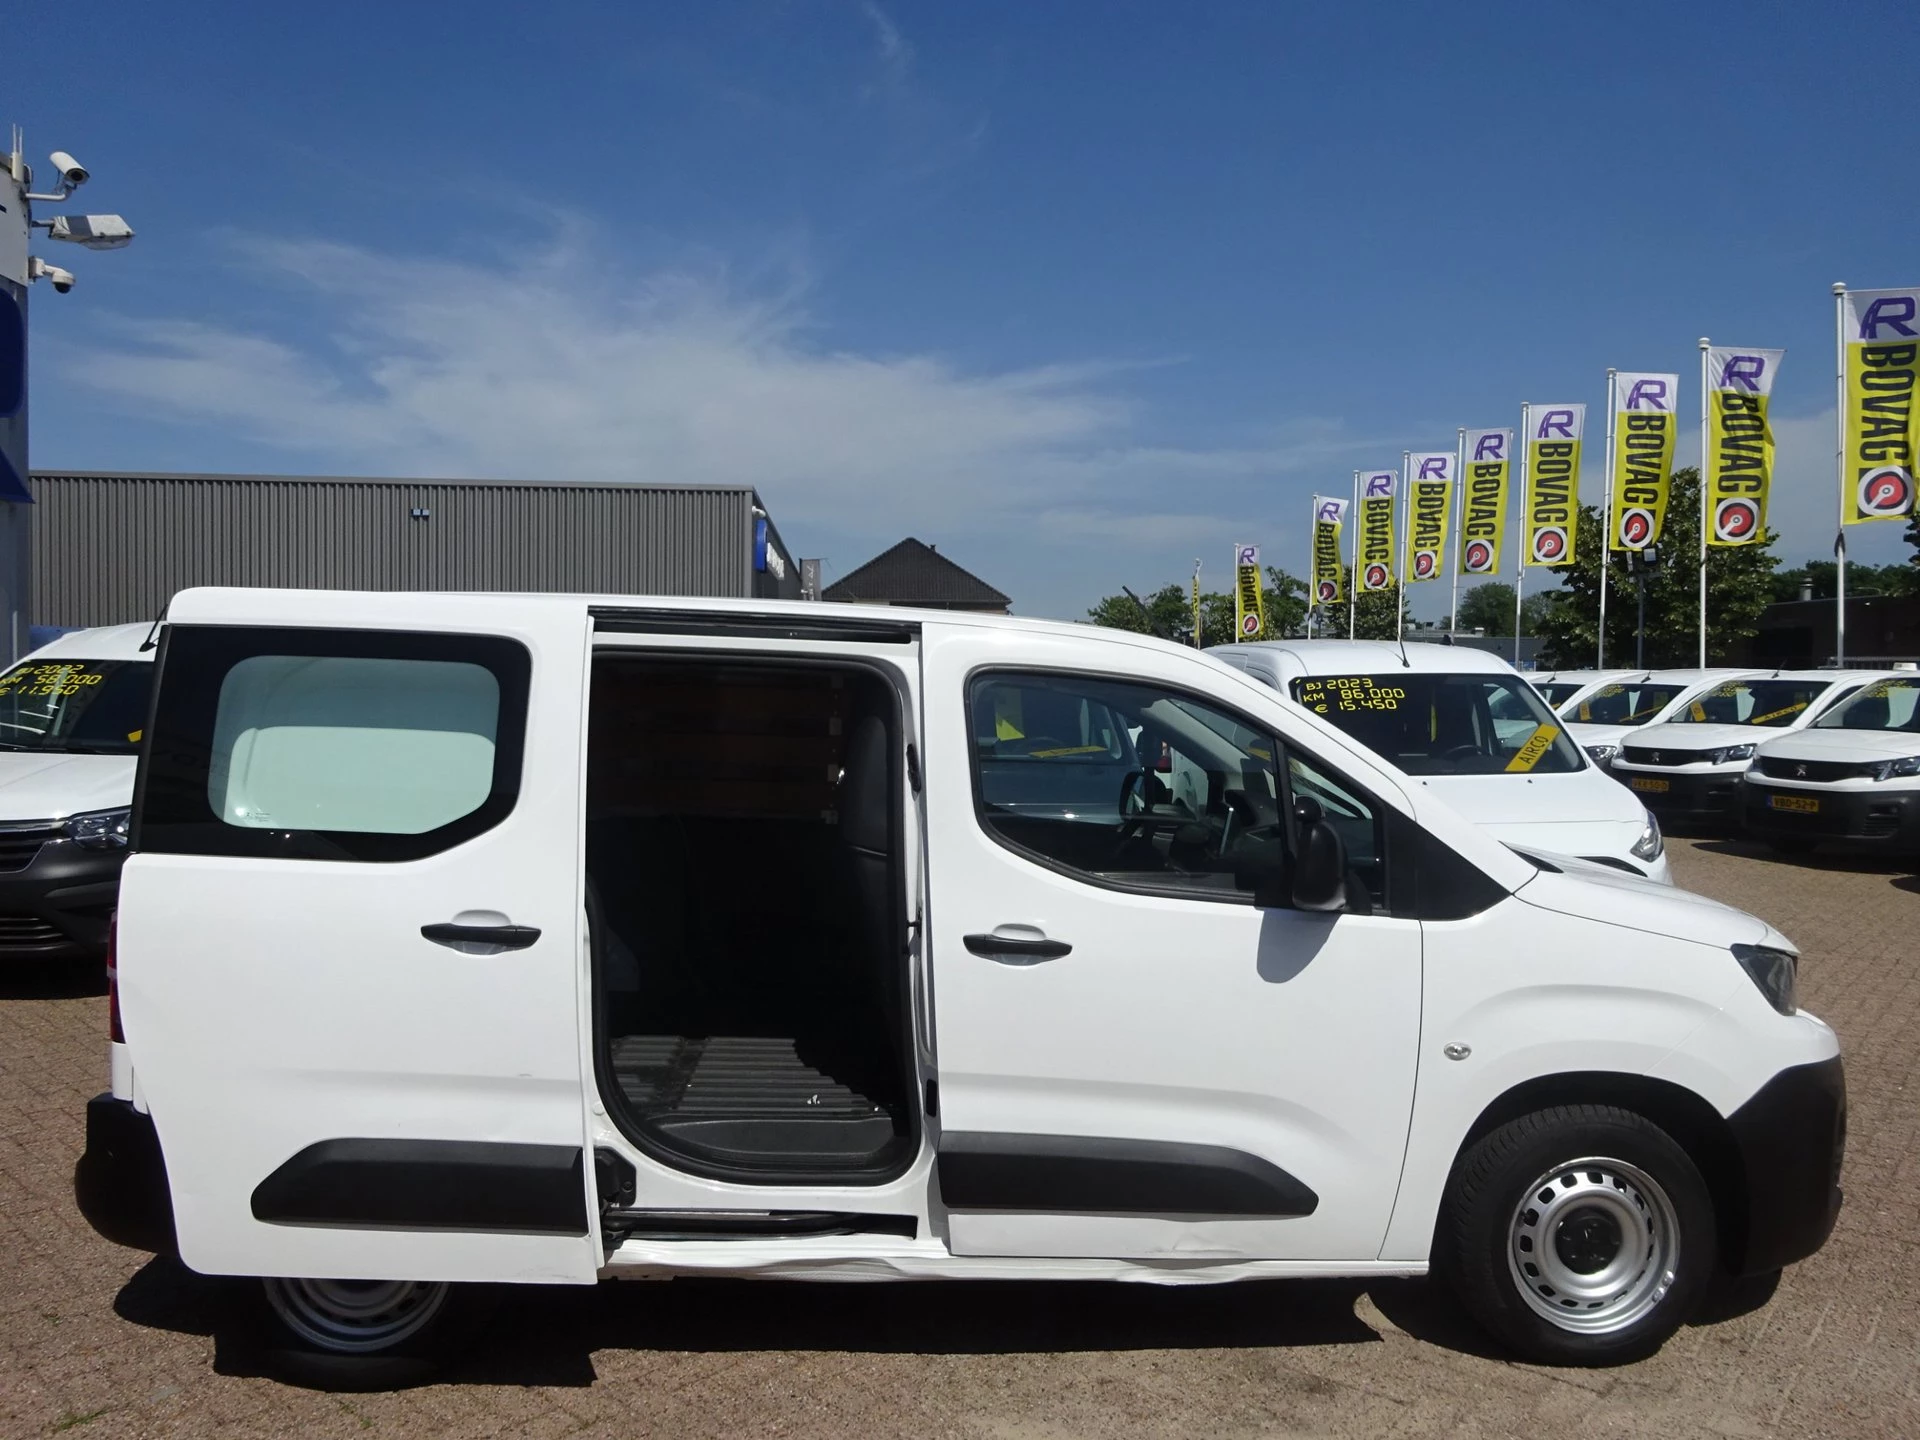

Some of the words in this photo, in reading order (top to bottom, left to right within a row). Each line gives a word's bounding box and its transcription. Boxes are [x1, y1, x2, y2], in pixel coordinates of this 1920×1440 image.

[1860, 344, 1917, 461] BOVAG
[1623, 415, 1666, 505] BOVAG
[1717, 393, 1763, 493] BOVAG
[1466, 463, 1500, 536] BOVAG
[1533, 443, 1573, 523] BOVAG
[1364, 499, 1390, 560] BOVAG
[1414, 483, 1446, 549] BOVAG
[1317, 523, 1338, 578] BOVAG
[1239, 566, 1257, 613] BOVAG
[34, 664, 84, 674] 2022
[34, 674, 102, 685] 58000
[1303, 692, 1325, 702] KM
[1340, 688, 1405, 699] 86.000
[1305, 682, 1322, 691] BJ
[1326, 678, 1373, 690] 2023
[1339, 699, 1397, 710] 15.450
[1518, 735, 1549, 764] AIRCO
